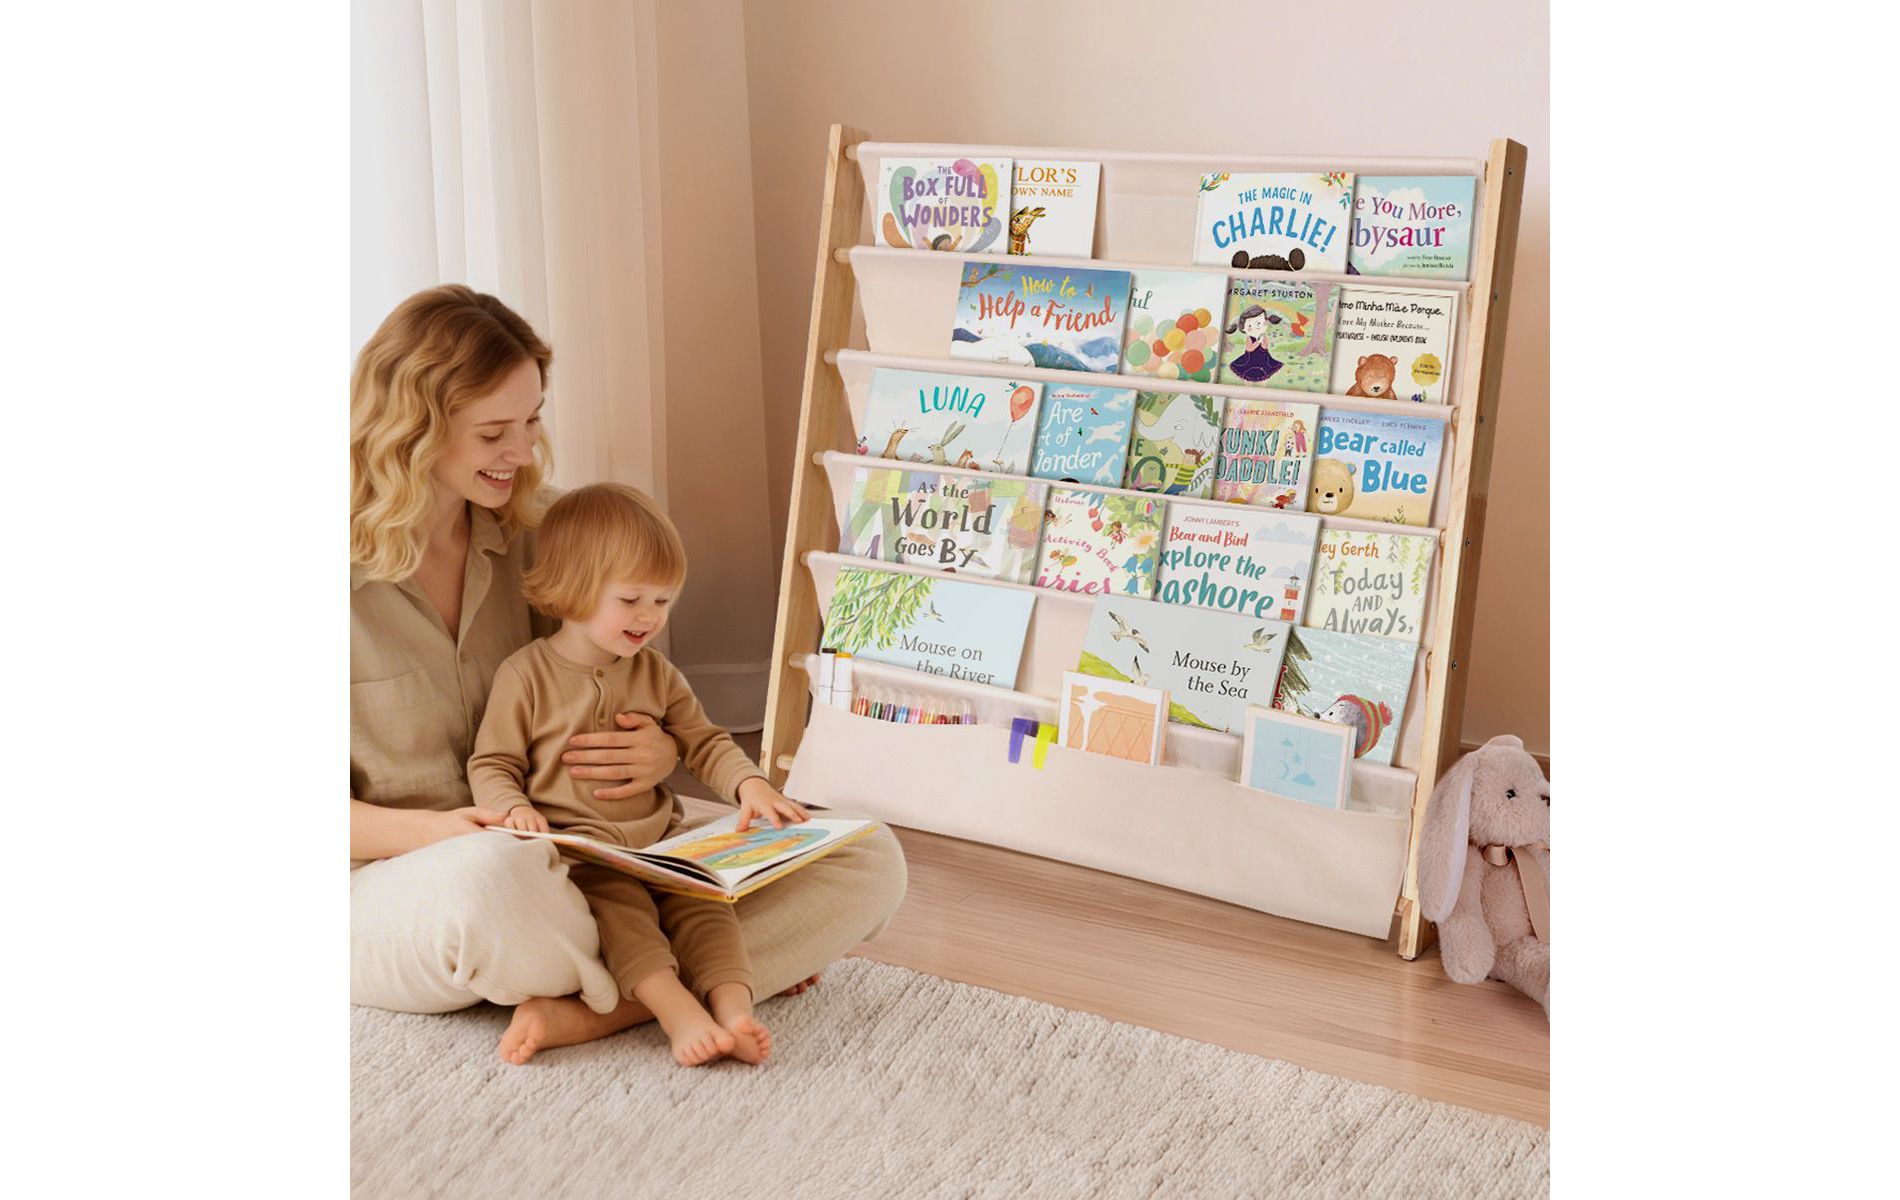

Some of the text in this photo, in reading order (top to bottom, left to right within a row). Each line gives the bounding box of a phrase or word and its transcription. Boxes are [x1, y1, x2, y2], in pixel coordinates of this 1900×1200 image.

[938, 166, 952, 175] THE
[1012, 167, 1077, 183] LOR'S
[945, 175, 988, 199] FULL
[1041, 187, 1074, 197] NAME
[1238, 187, 1312, 205] THE MAGIC IN
[899, 205, 993, 229] WONDERS
[1371, 196, 1404, 219] You
[1408, 202, 1462, 221] More,
[1212, 206, 1337, 253] CHARLIE!
[1350, 218, 1446, 255] bysaur
[1021, 275, 1077, 298] How to
[978, 290, 1117, 332] Help a Friend
[1355, 301, 1384, 311] Minha
[919, 386, 986, 418] LUNA
[1042, 401, 1084, 431] Are
[1056, 426, 1073, 447] of
[1318, 426, 1426, 457] Bear called
[1362, 460, 1427, 494] Blue
[917, 482, 969, 499] As the
[892, 497, 997, 535] World
[895, 537, 935, 556] Goes
[1043, 534, 1092, 553] Activity
[1169, 526, 1249, 548] Bear and Bird
[1341, 541, 1379, 558] Gerth
[1235, 555, 1267, 581] the
[1329, 568, 1403, 600] Today
[1352, 595, 1383, 612] AND
[900, 634, 983, 661] Mouse on
[916, 660, 994, 685] the River
[1172, 651, 1250, 683] Mouse by
[1187, 676, 1248, 699] the Sea
